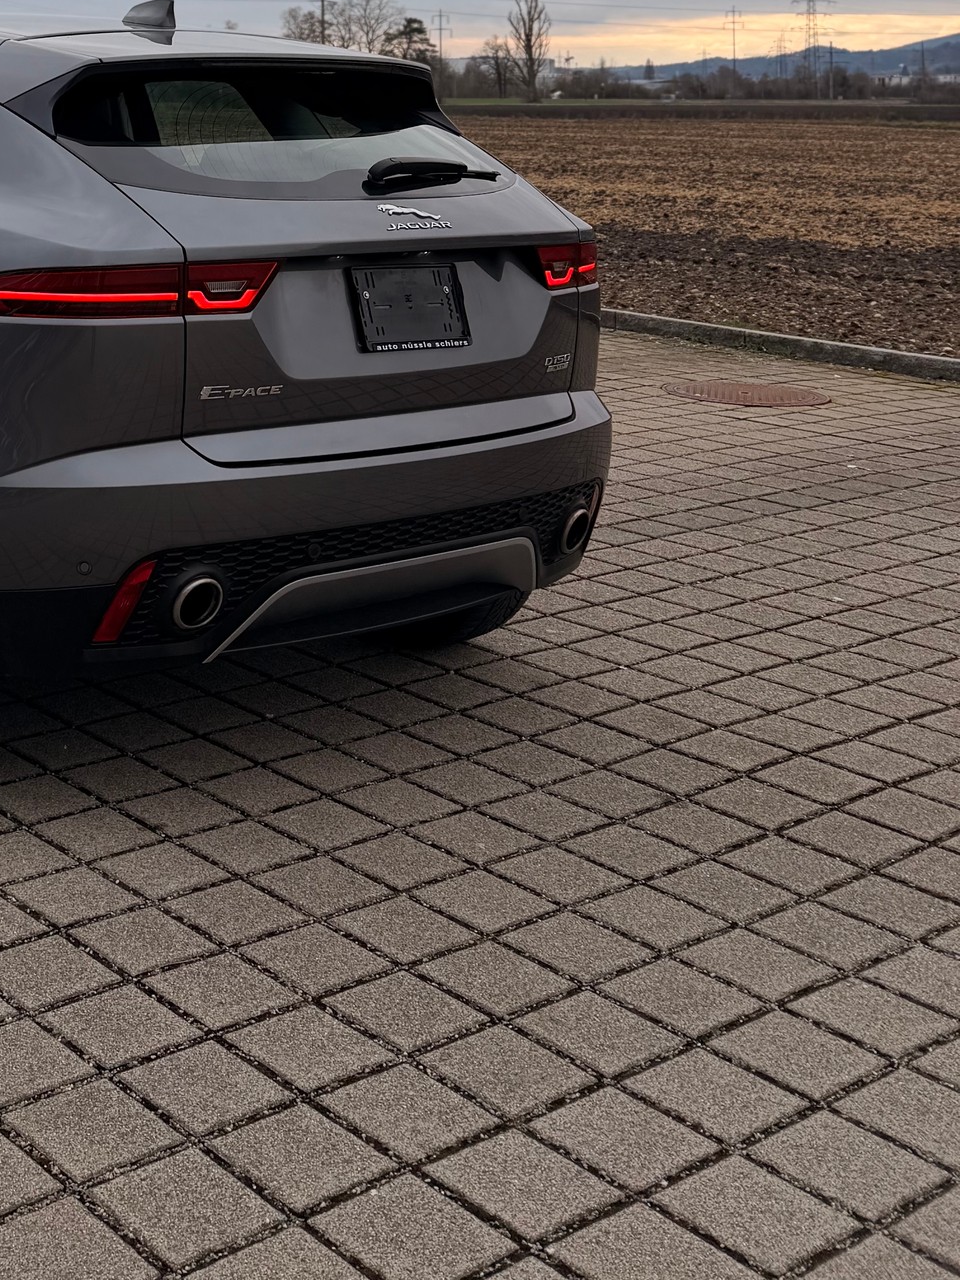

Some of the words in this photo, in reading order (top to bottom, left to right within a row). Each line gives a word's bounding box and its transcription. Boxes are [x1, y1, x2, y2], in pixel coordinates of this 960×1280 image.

[386, 221, 453, 231] JAGUAR
[376, 343, 399, 351] auto
[435, 339, 469, 348] schiers
